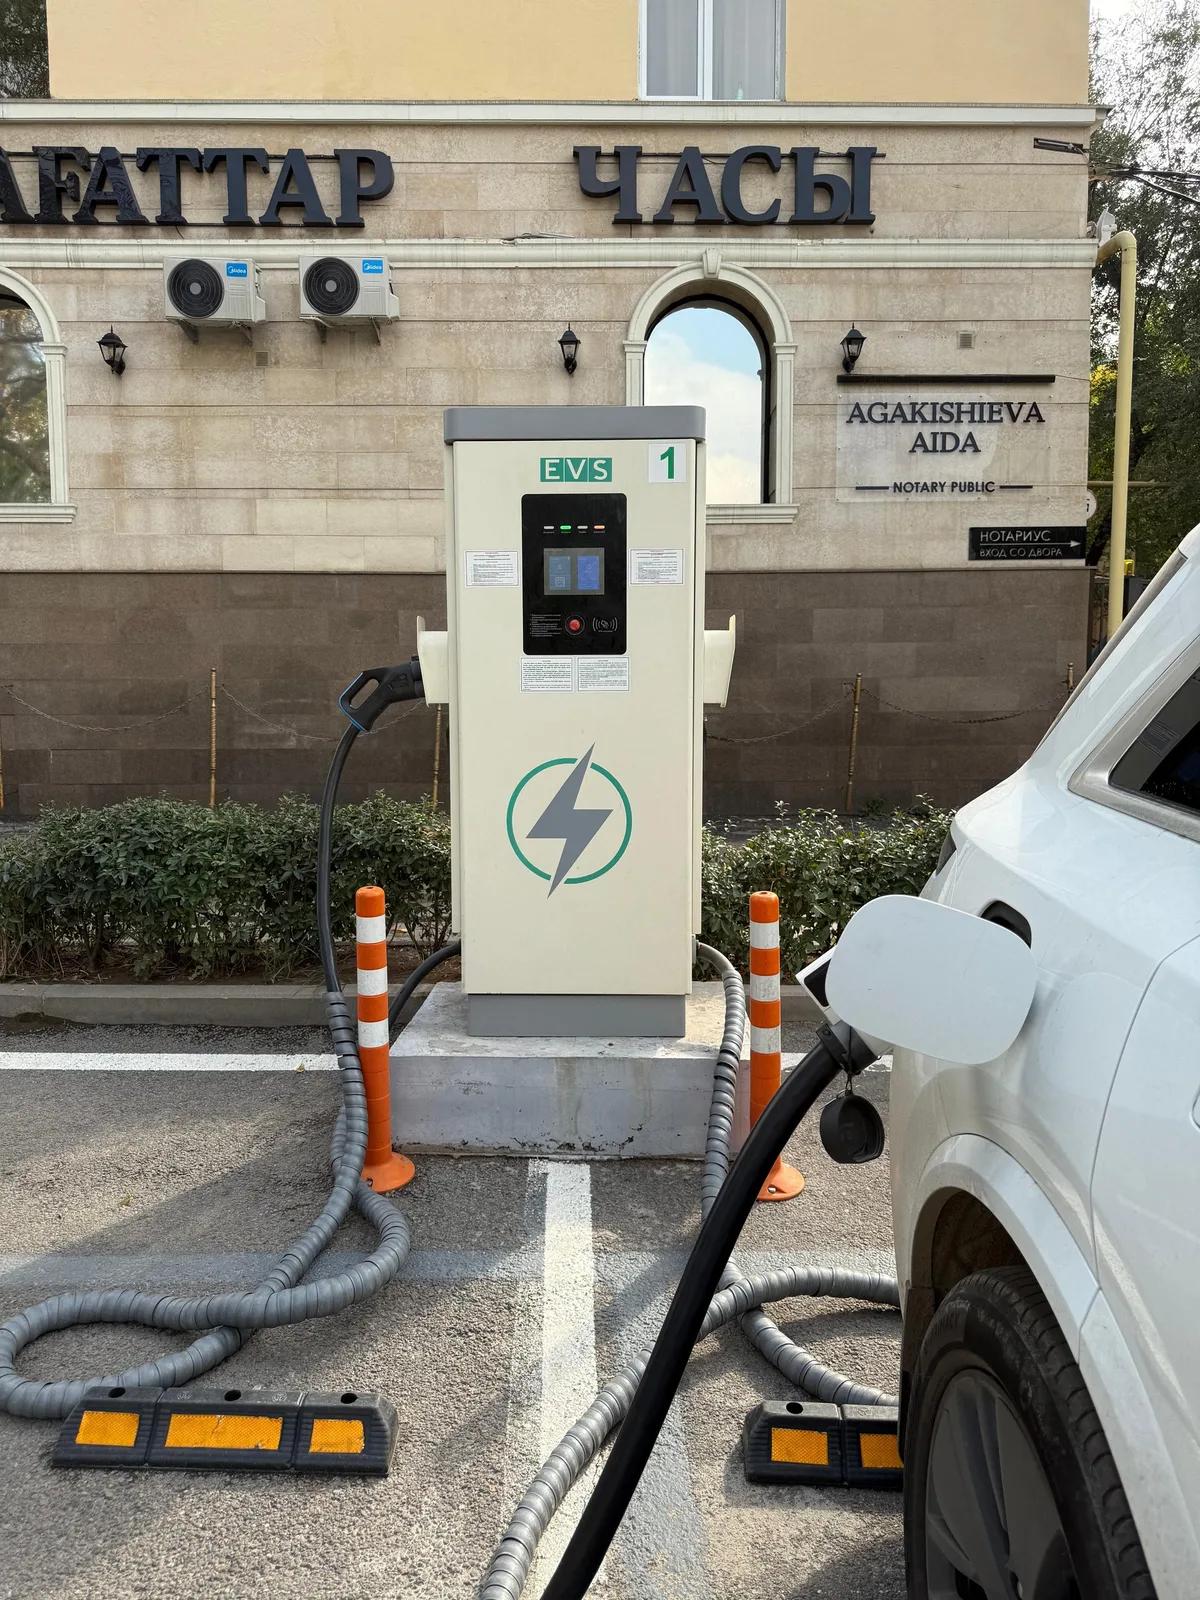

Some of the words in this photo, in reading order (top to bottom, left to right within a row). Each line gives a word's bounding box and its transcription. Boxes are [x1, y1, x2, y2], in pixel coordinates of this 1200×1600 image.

[573, 145, 877, 225] ЧАСЫ
[846, 401, 1046, 424] AGAKISHIEVA
[908, 431, 982, 453] AIDA
[544, 458, 609, 481] EVS
[659, 446, 676, 480] 1
[893, 481, 947, 493] NOTARY
[950, 481, 996, 493] PUBLIC
[980, 530, 1052, 542] НОТАРИУС
[979, 548, 1008, 558] ВХОД
[1009, 547, 1026, 557] СО
[1028, 547, 1063, 558] ДВОРА
